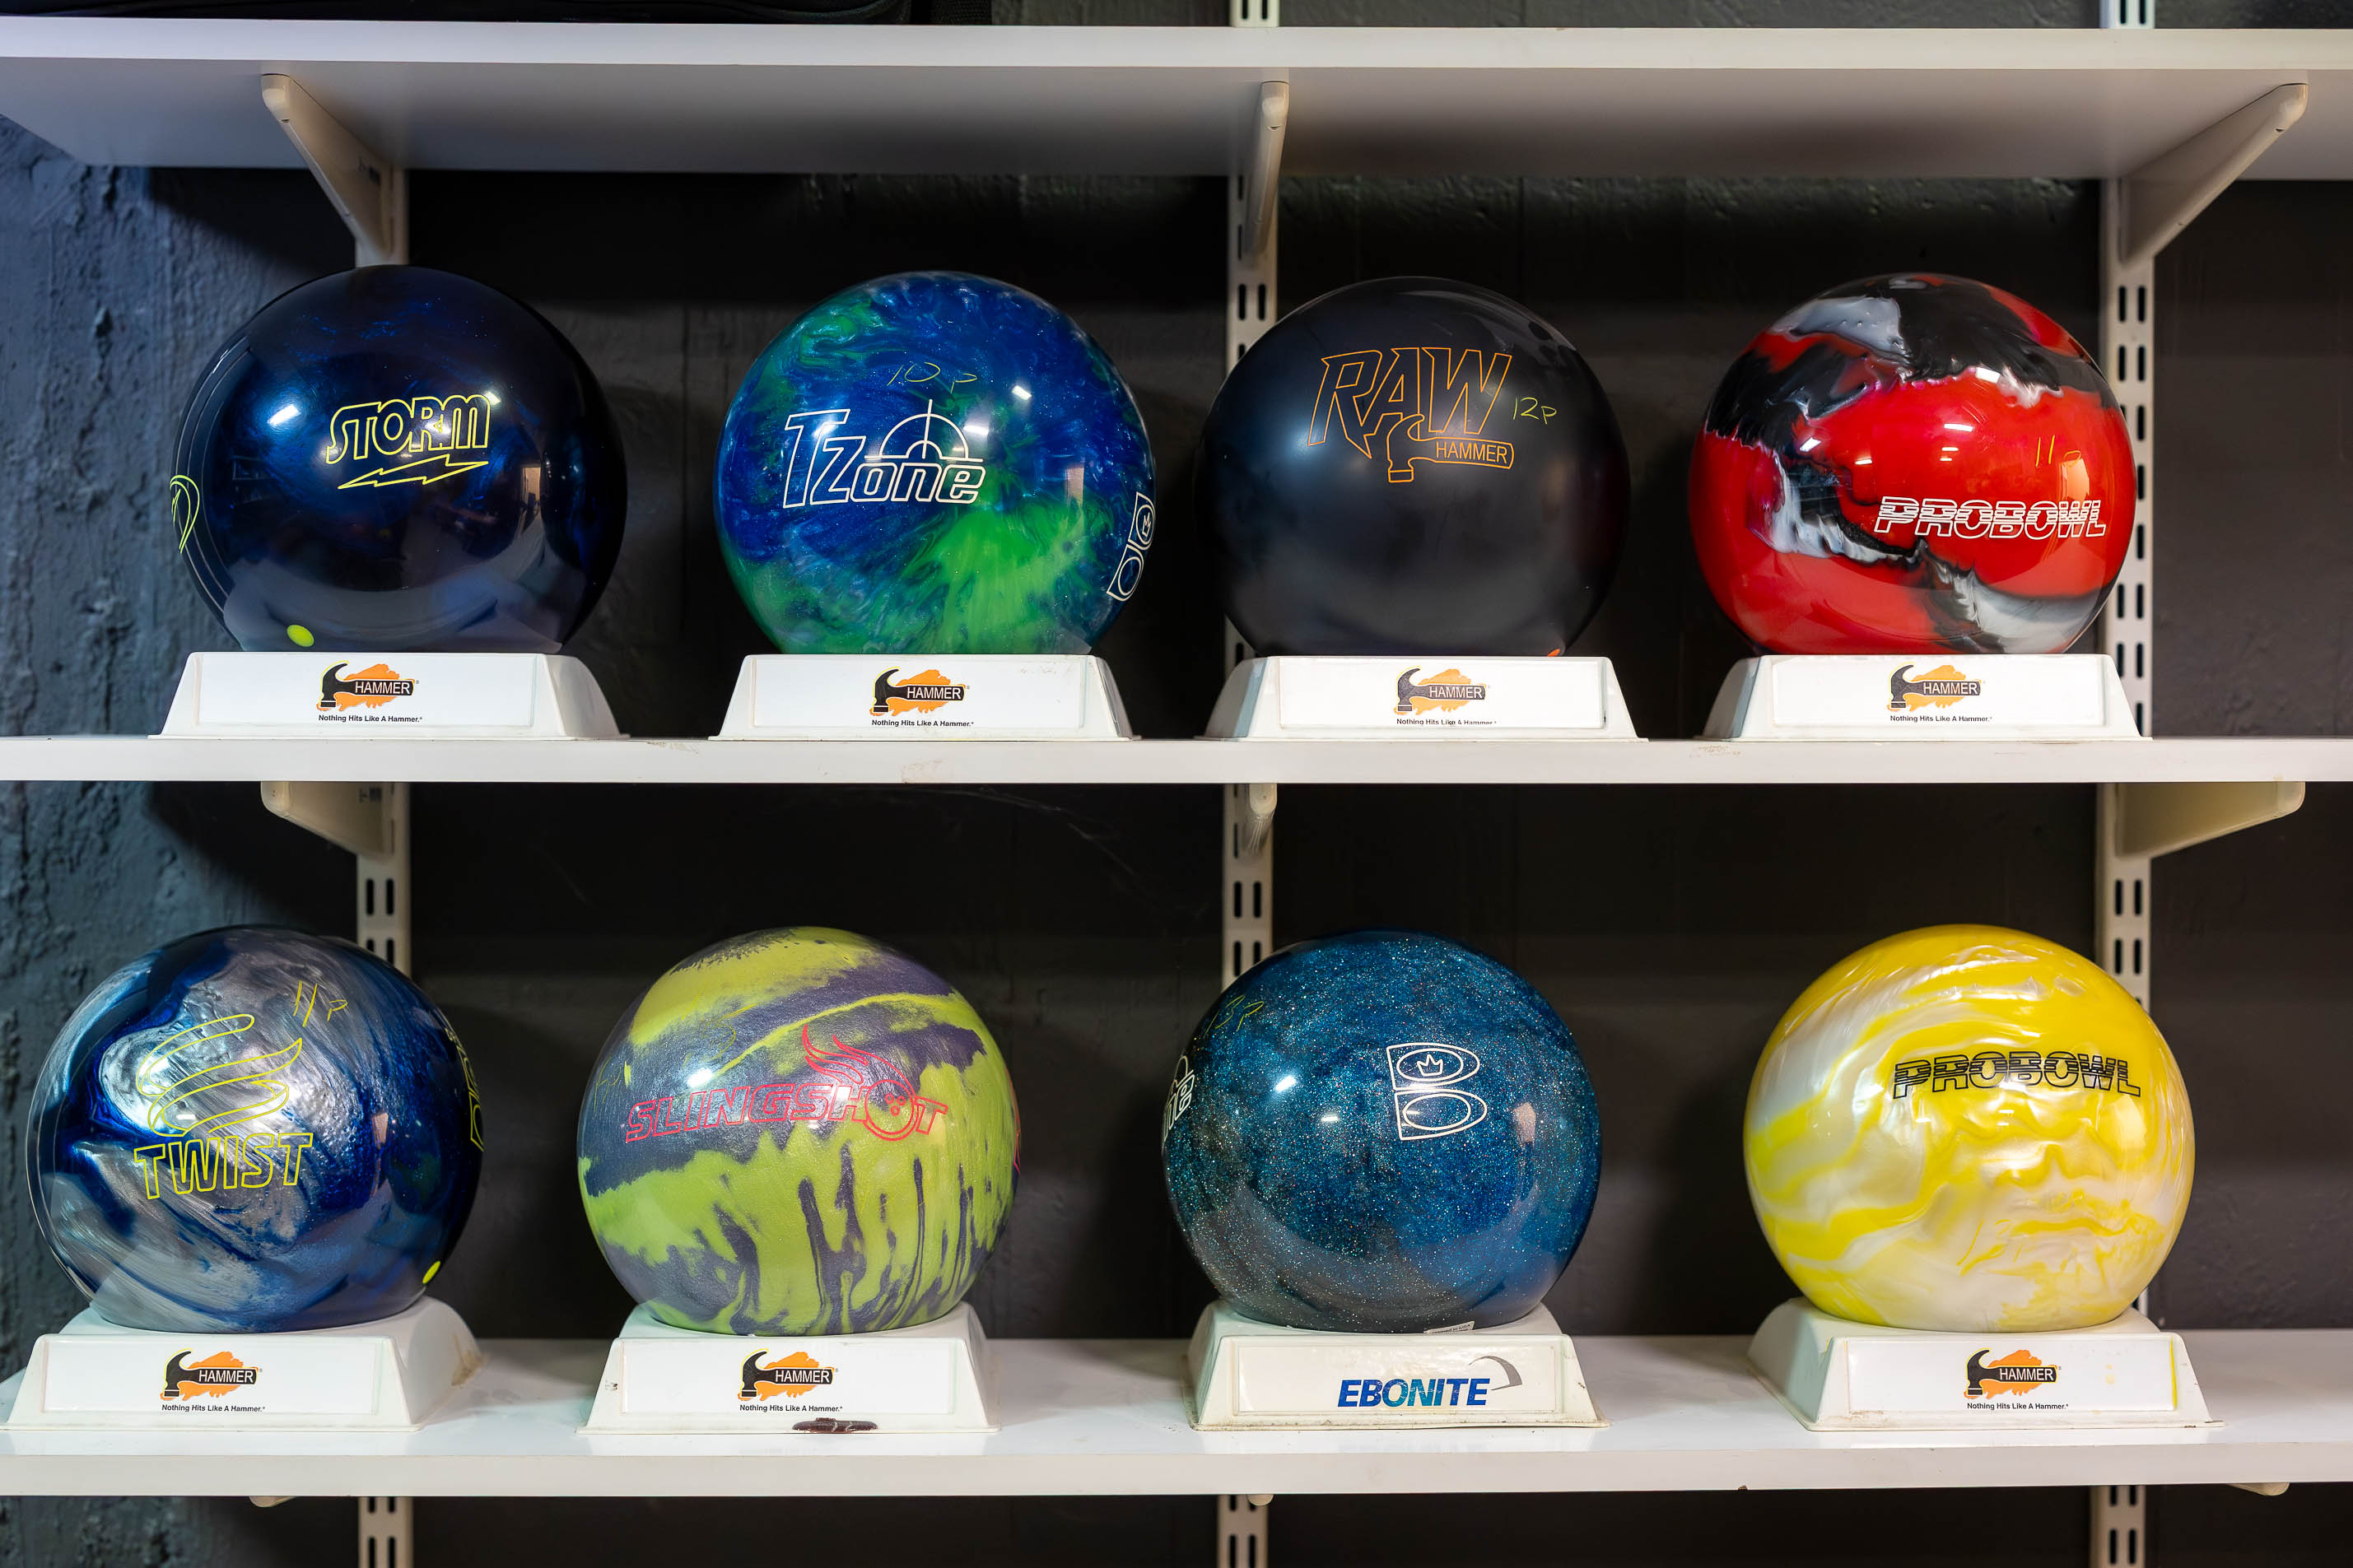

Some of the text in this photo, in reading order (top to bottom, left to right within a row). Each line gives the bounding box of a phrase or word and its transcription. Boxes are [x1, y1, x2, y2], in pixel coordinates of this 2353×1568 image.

[1307, 347, 1512, 459] RAW
[326, 394, 491, 464] STORM
[1435, 440, 1507, 464] HAMMER
[1874, 496, 2106, 540] PROBOWL
[355, 682, 410, 694] HAMMER
[907, 686, 961, 699] HAMMER
[1429, 686, 1482, 698] HAMMER
[1923, 682, 1978, 694] HAMMER
[1893, 1051, 2141, 1100] PROBOWL
[133, 1132, 314, 1200] TWIST
[198, 1370, 254, 1382] HAMMER
[776, 1370, 829, 1382] HAMMER
[1999, 1369, 2053, 1380] HAMMER
[1337, 1378, 1491, 1407] EBONITE
